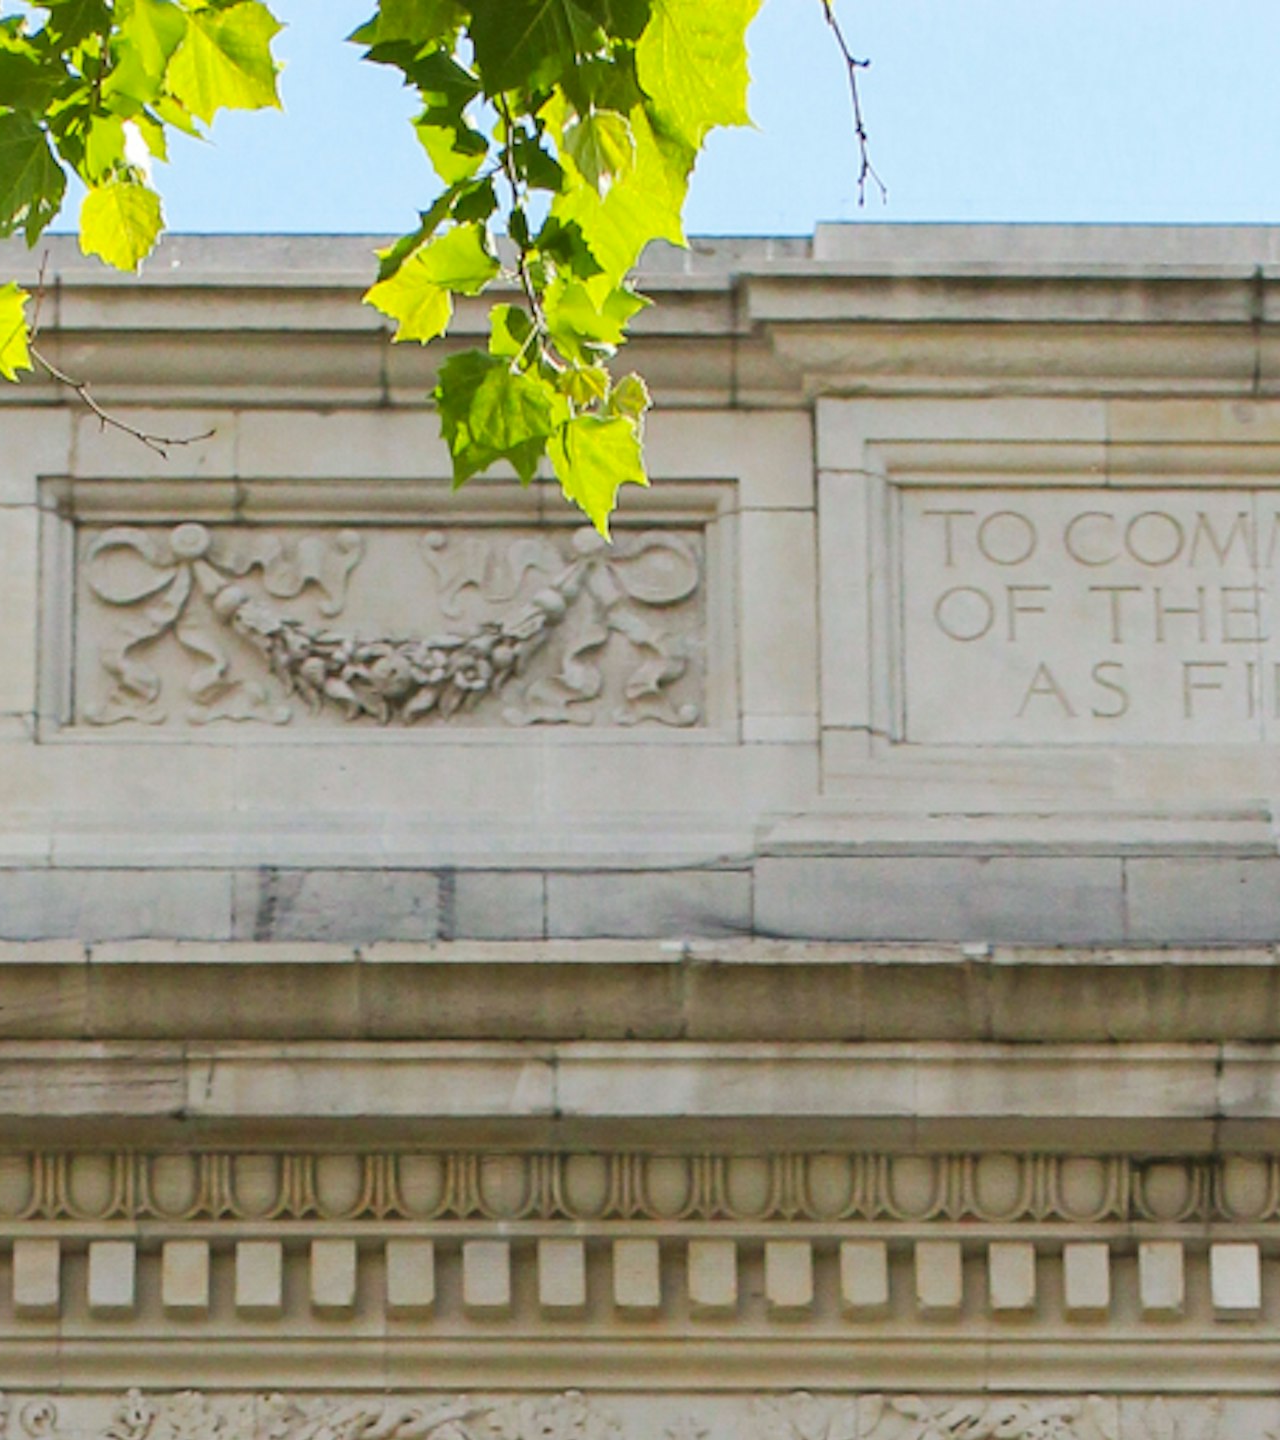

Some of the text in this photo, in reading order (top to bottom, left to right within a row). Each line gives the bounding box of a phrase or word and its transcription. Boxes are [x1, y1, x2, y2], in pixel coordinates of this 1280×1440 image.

[922, 510, 1037, 567] TO
[934, 585, 1052, 643] OF
[1088, 585, 1269, 644] THE
[1017, 660, 1129, 719] AS
